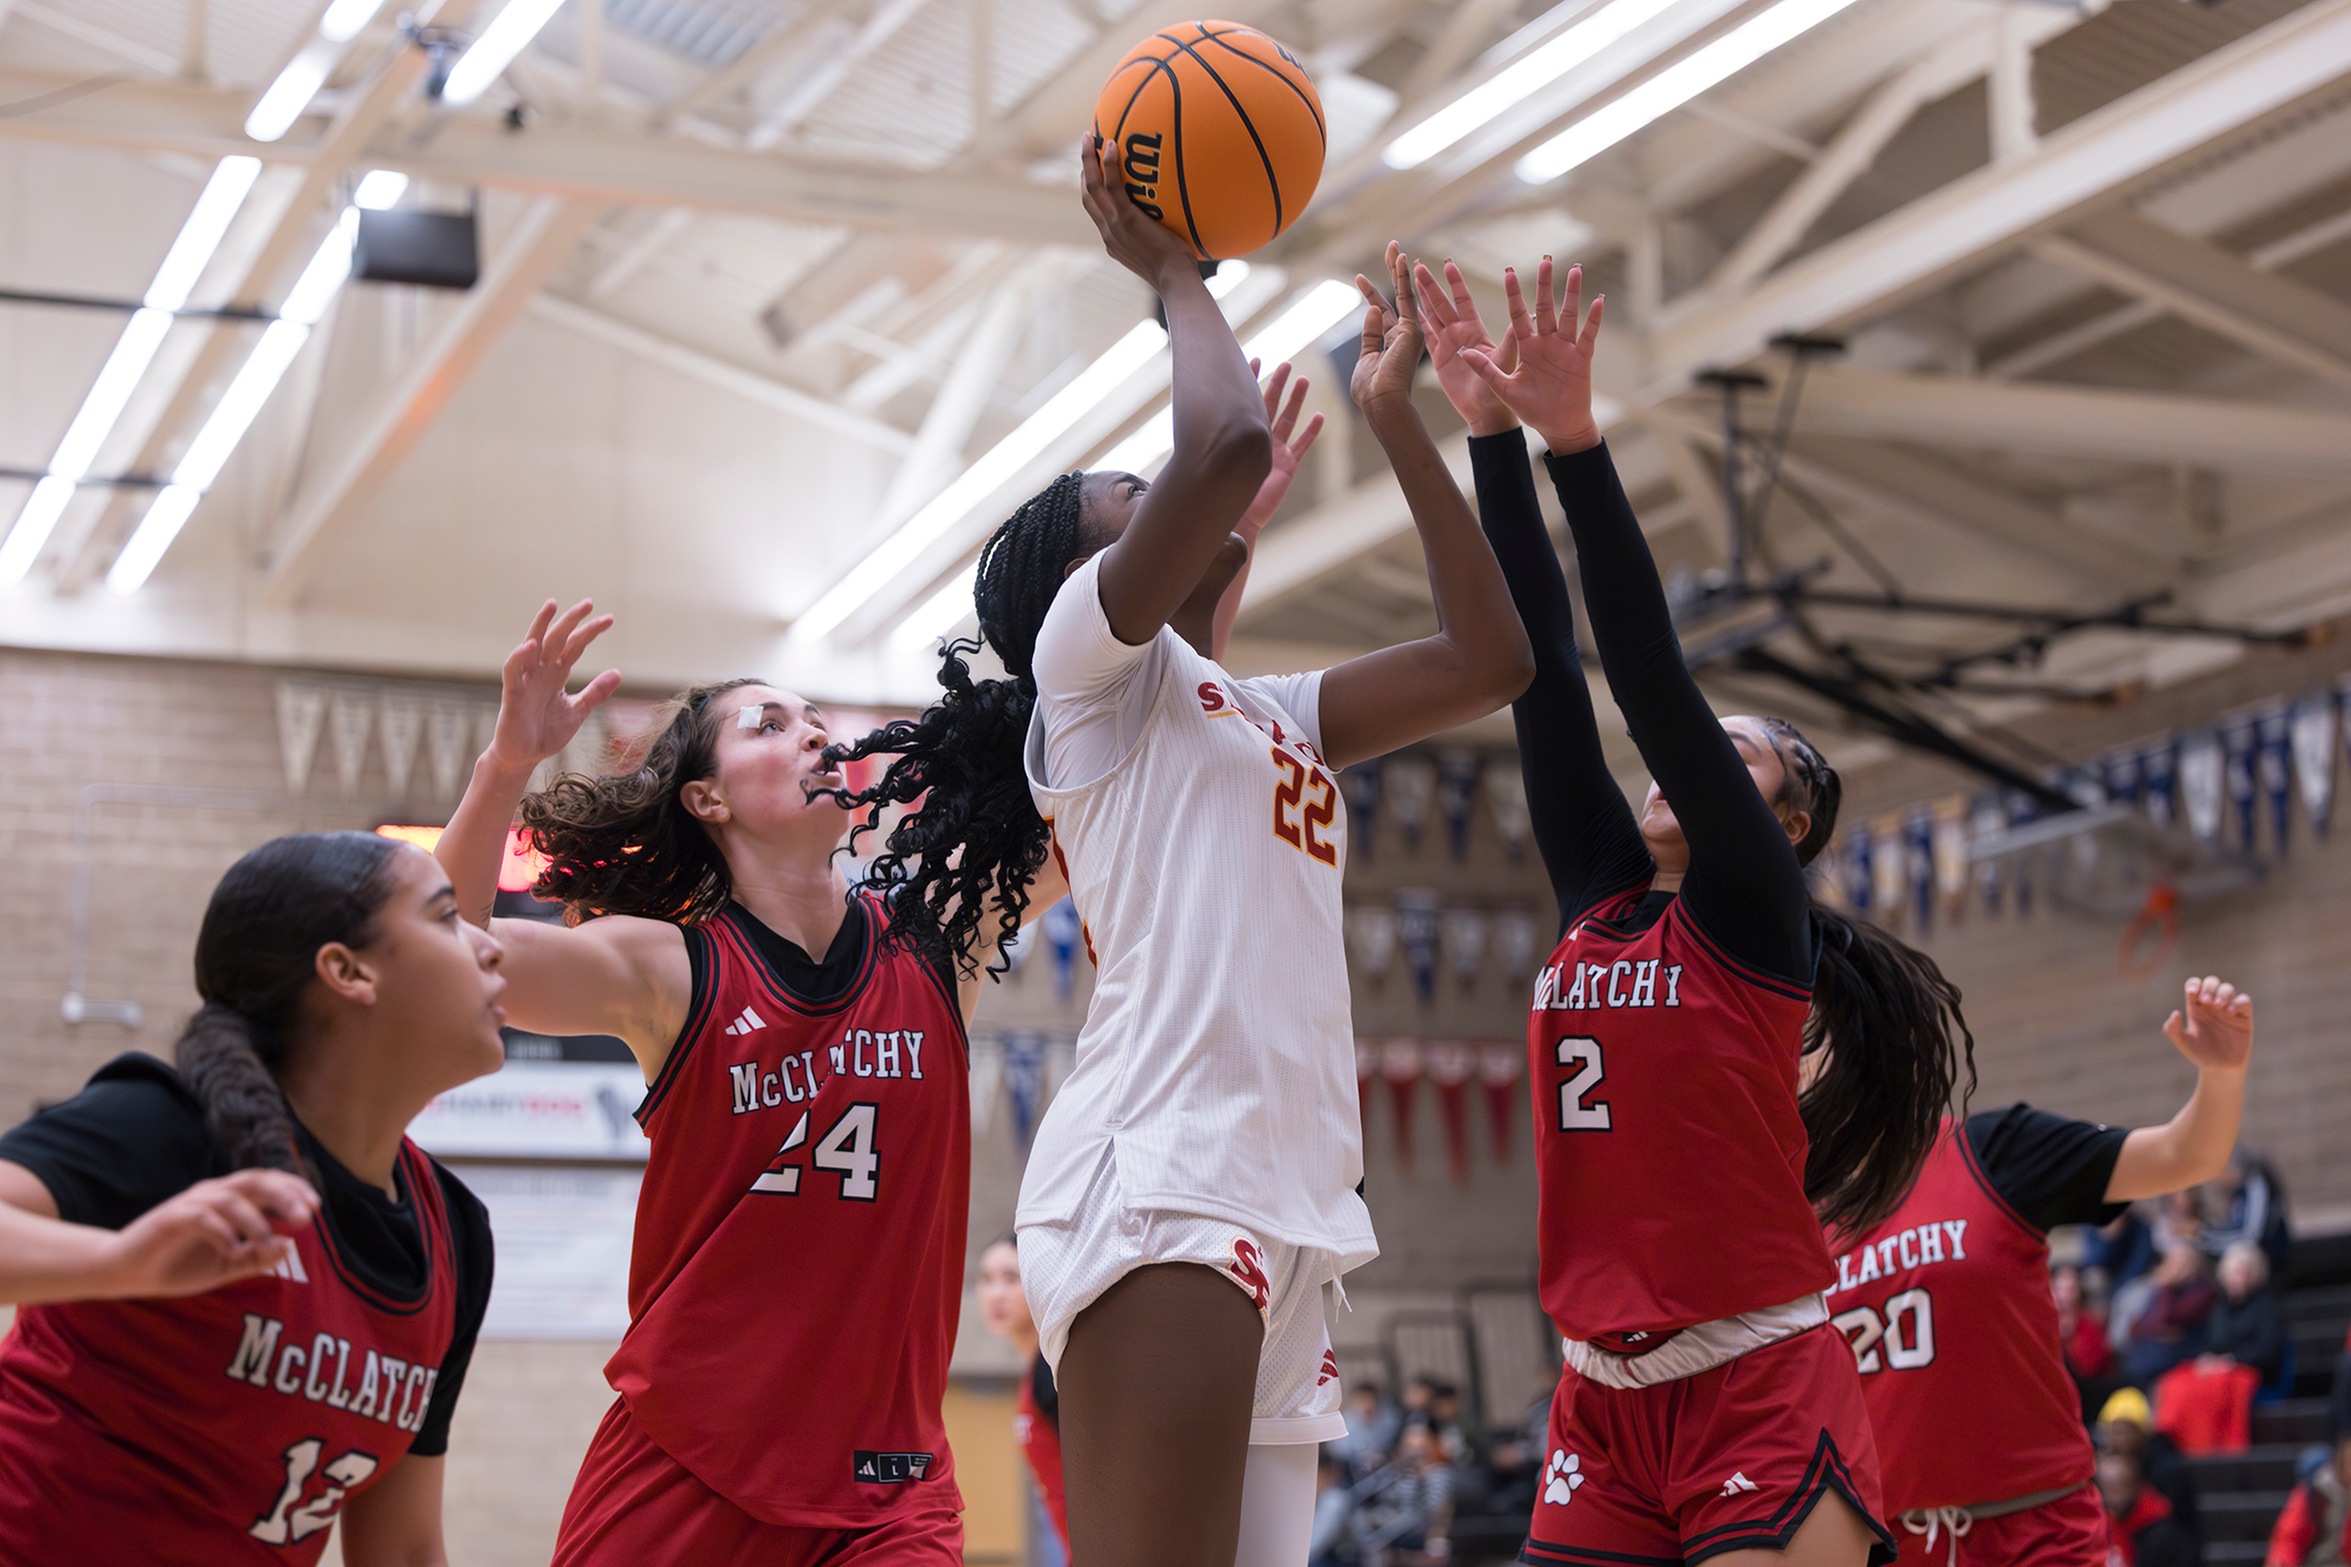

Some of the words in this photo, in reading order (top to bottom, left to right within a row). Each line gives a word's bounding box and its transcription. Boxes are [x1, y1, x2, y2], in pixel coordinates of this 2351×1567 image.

[1270, 745, 1338, 869] 22
[1555, 1034, 1613, 1132] 2
[1831, 1287, 1937, 1374] 20
[248, 1437, 379, 1545] 12
